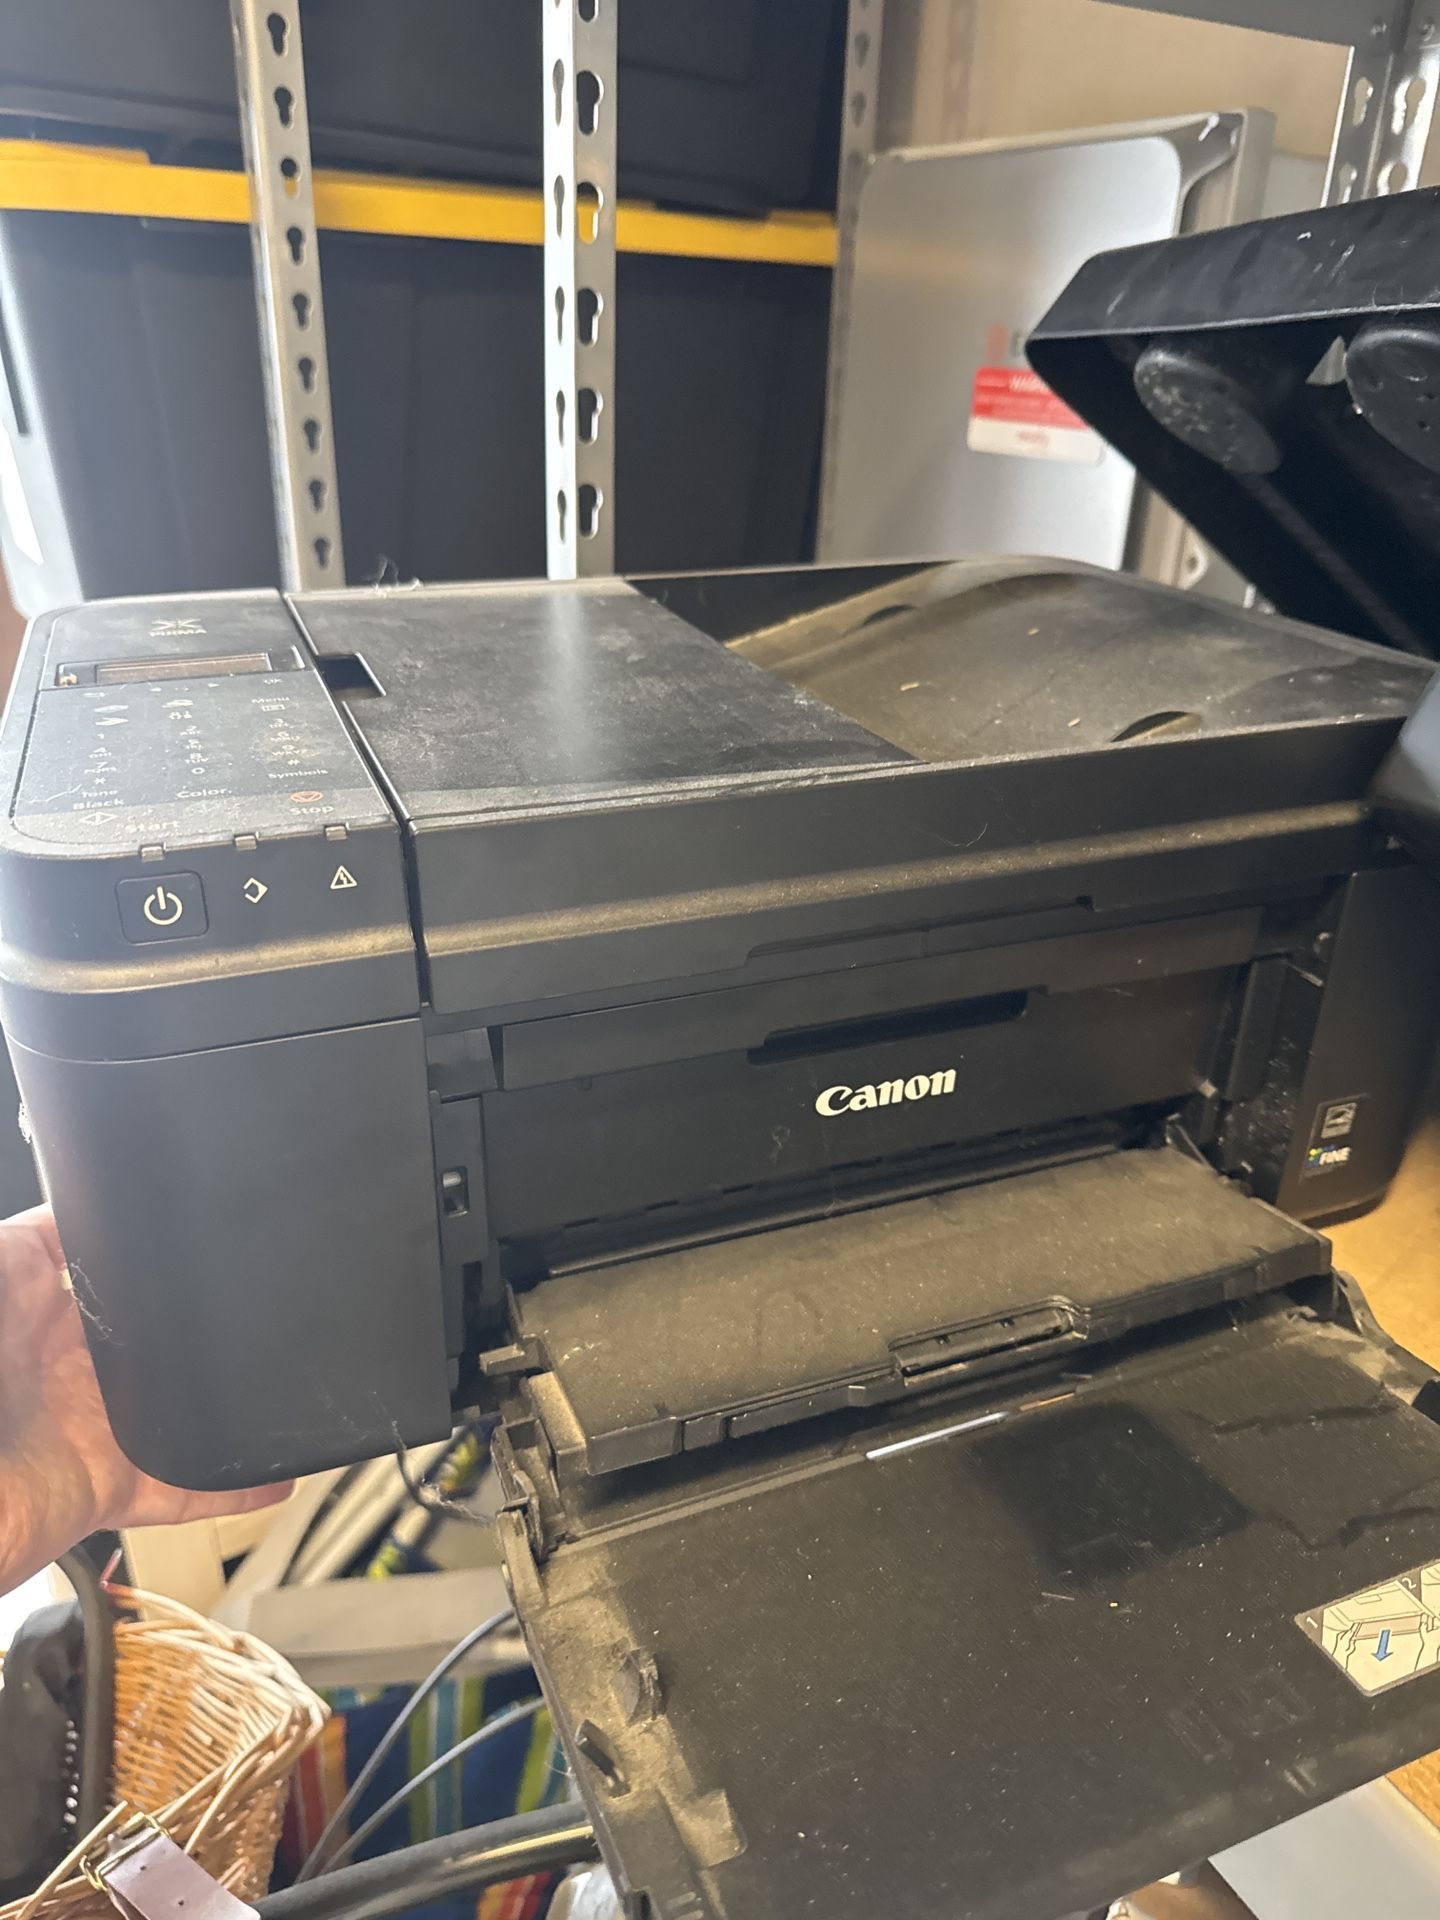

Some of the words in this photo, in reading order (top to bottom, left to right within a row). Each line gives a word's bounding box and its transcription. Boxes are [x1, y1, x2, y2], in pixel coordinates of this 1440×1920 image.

[251, 696, 290, 704] Menu
[268, 768, 328, 779] Symbols
[81, 789, 118, 799] Tone
[176, 788, 227, 798] Color
[72, 798, 124, 811] Black
[289, 805, 334, 816] Stop
[124, 819, 180, 834] Start
[815, 1068, 957, 1117] Canon
[1401, 1576, 1417, 1590] 2
[1306, 1615, 1319, 1630] 1
